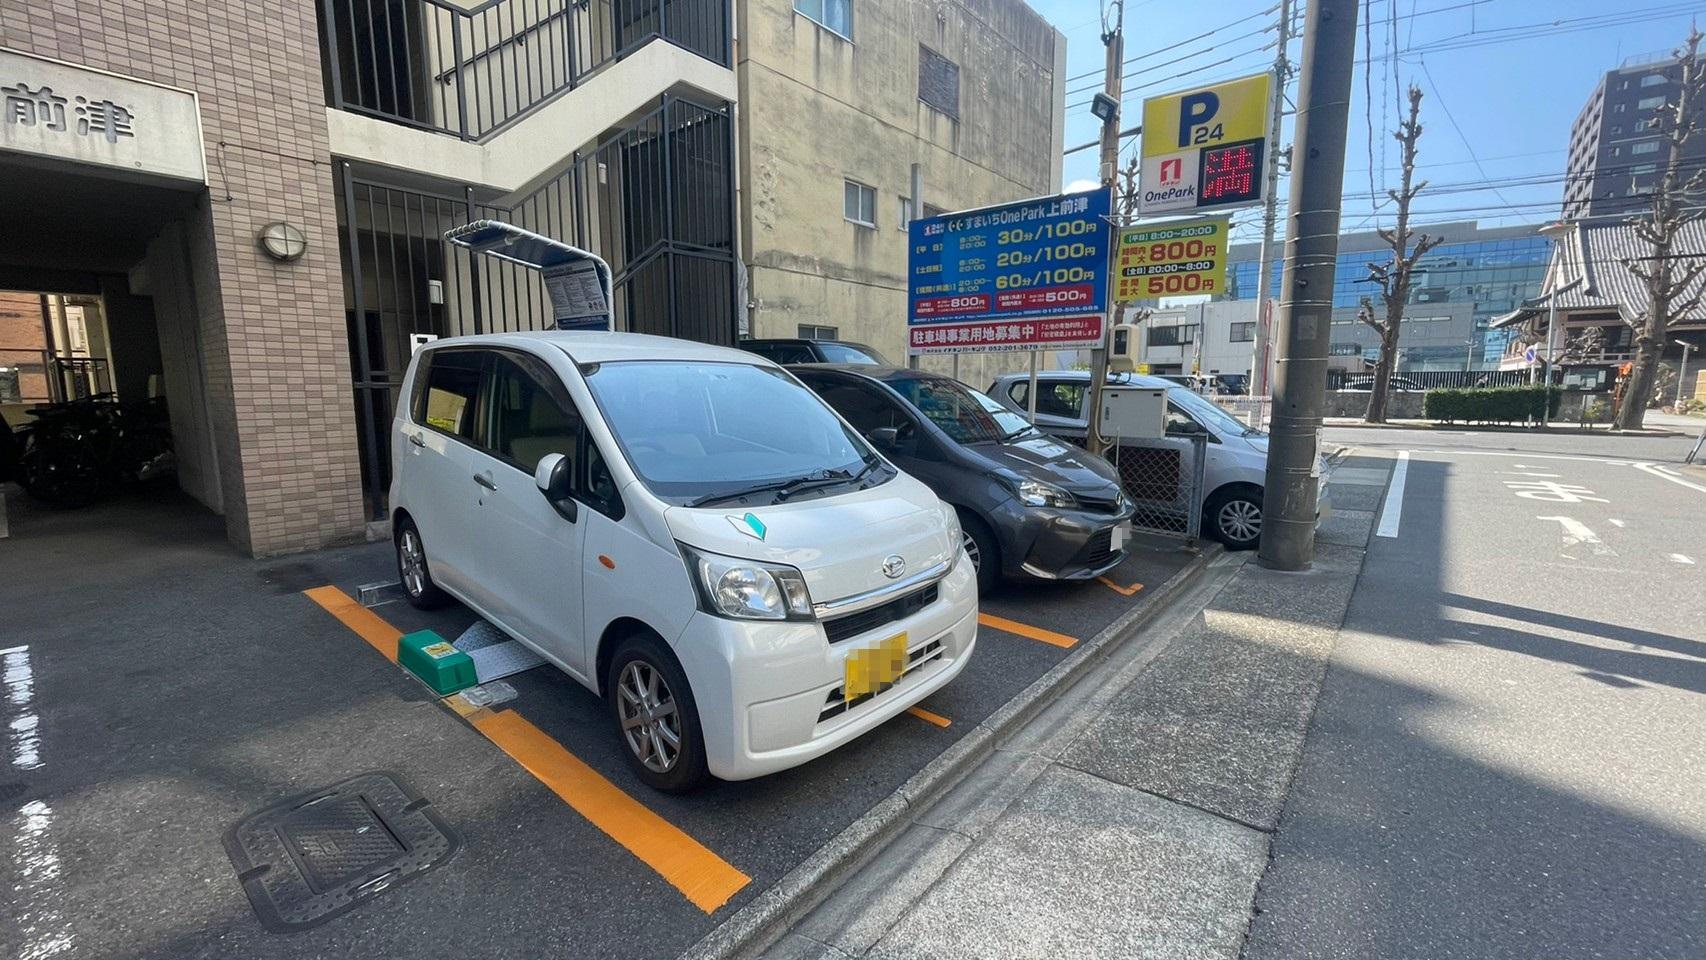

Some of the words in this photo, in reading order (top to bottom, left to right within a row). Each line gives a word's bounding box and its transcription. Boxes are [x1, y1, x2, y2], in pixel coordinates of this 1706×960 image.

[1, 83, 134, 144] 前津
[1178, 91, 1220, 148] P
[1193, 123, 1224, 145] 24
[1203, 144, 1254, 198] 満
[1144, 184, 1196, 202] OnePark
[1150, 240, 1216, 262] 800円
[1147, 274, 1214, 294] 500円
